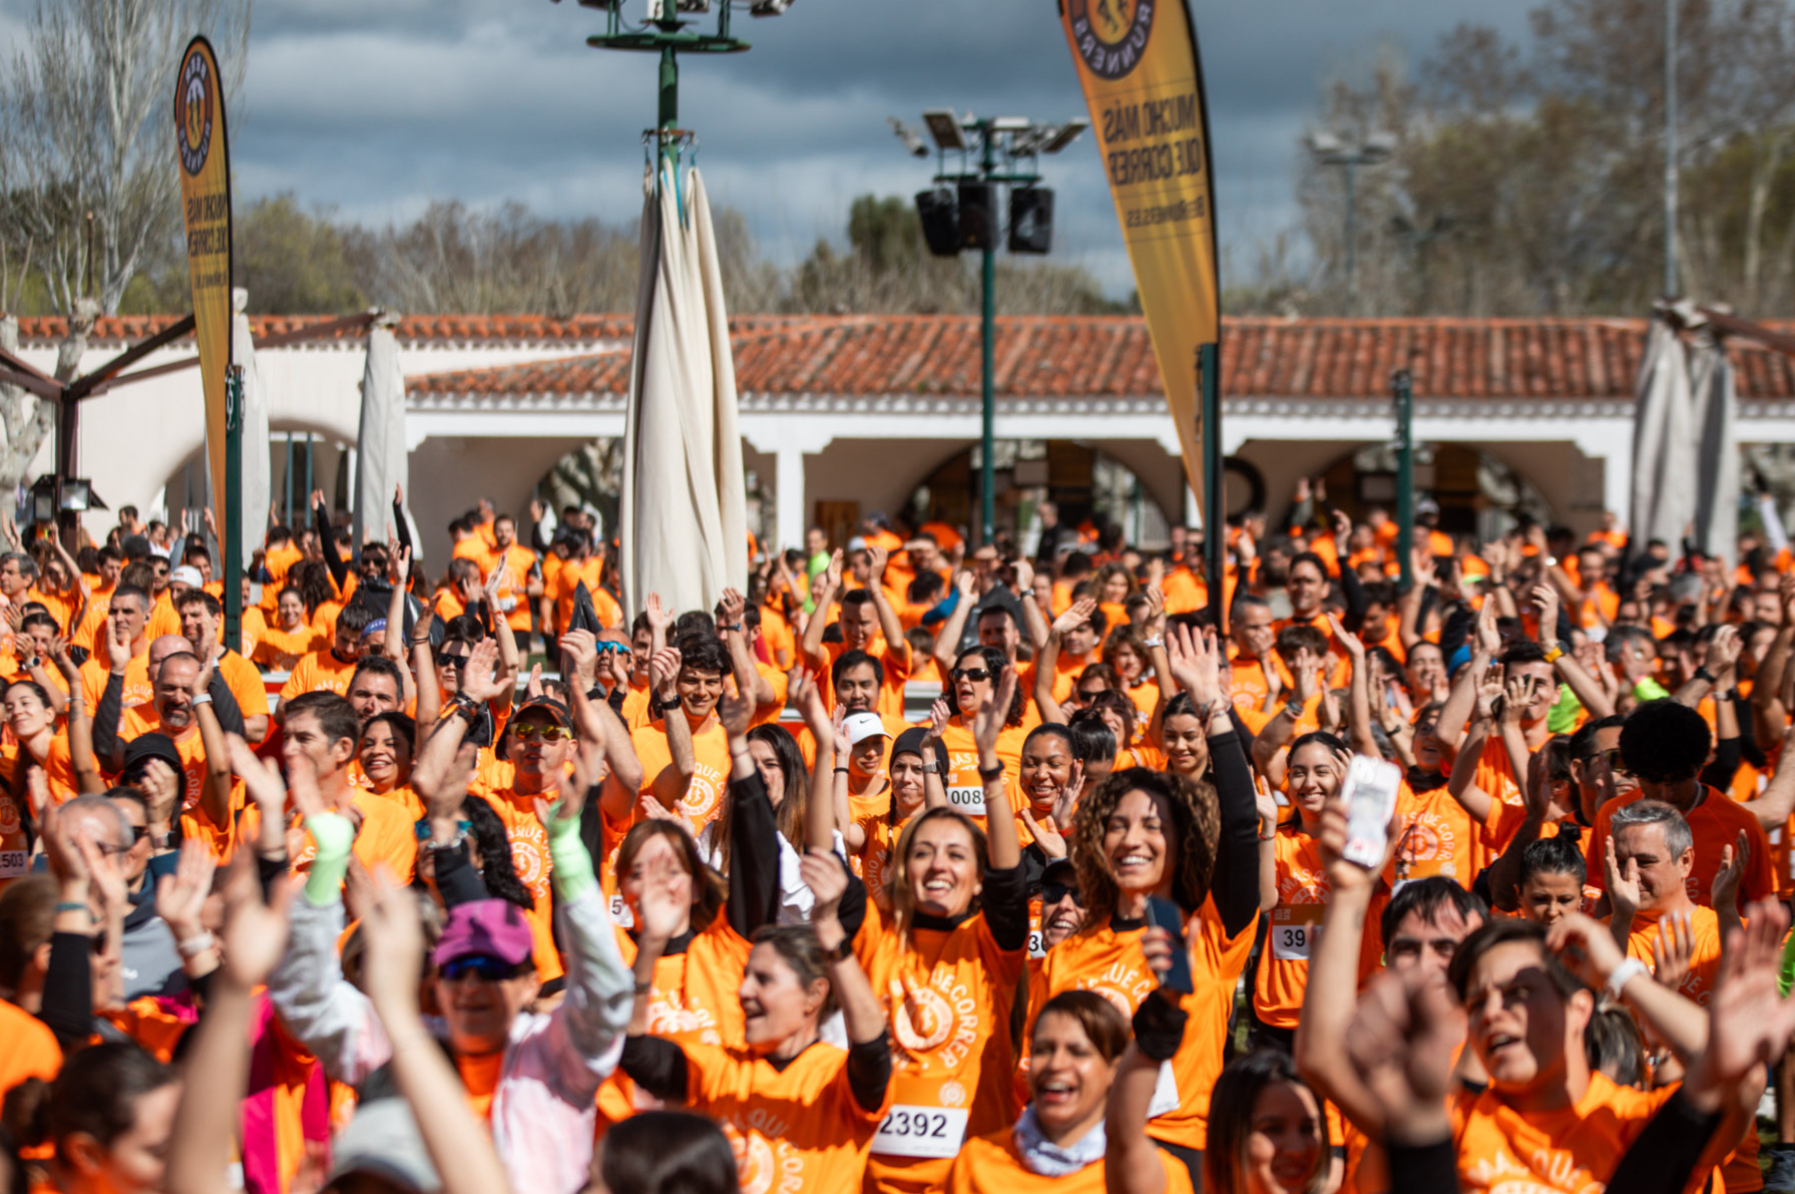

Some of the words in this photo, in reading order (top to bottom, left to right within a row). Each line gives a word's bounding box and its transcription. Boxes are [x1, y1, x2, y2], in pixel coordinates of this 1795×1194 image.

[694, 762, 721, 782] QUE
[951, 790, 986, 805] 008
[0, 853, 24, 869] 503
[1283, 929, 1305, 947] 39
[940, 984, 979, 1068] CORRER
[880, 1112, 947, 1137] 2392
